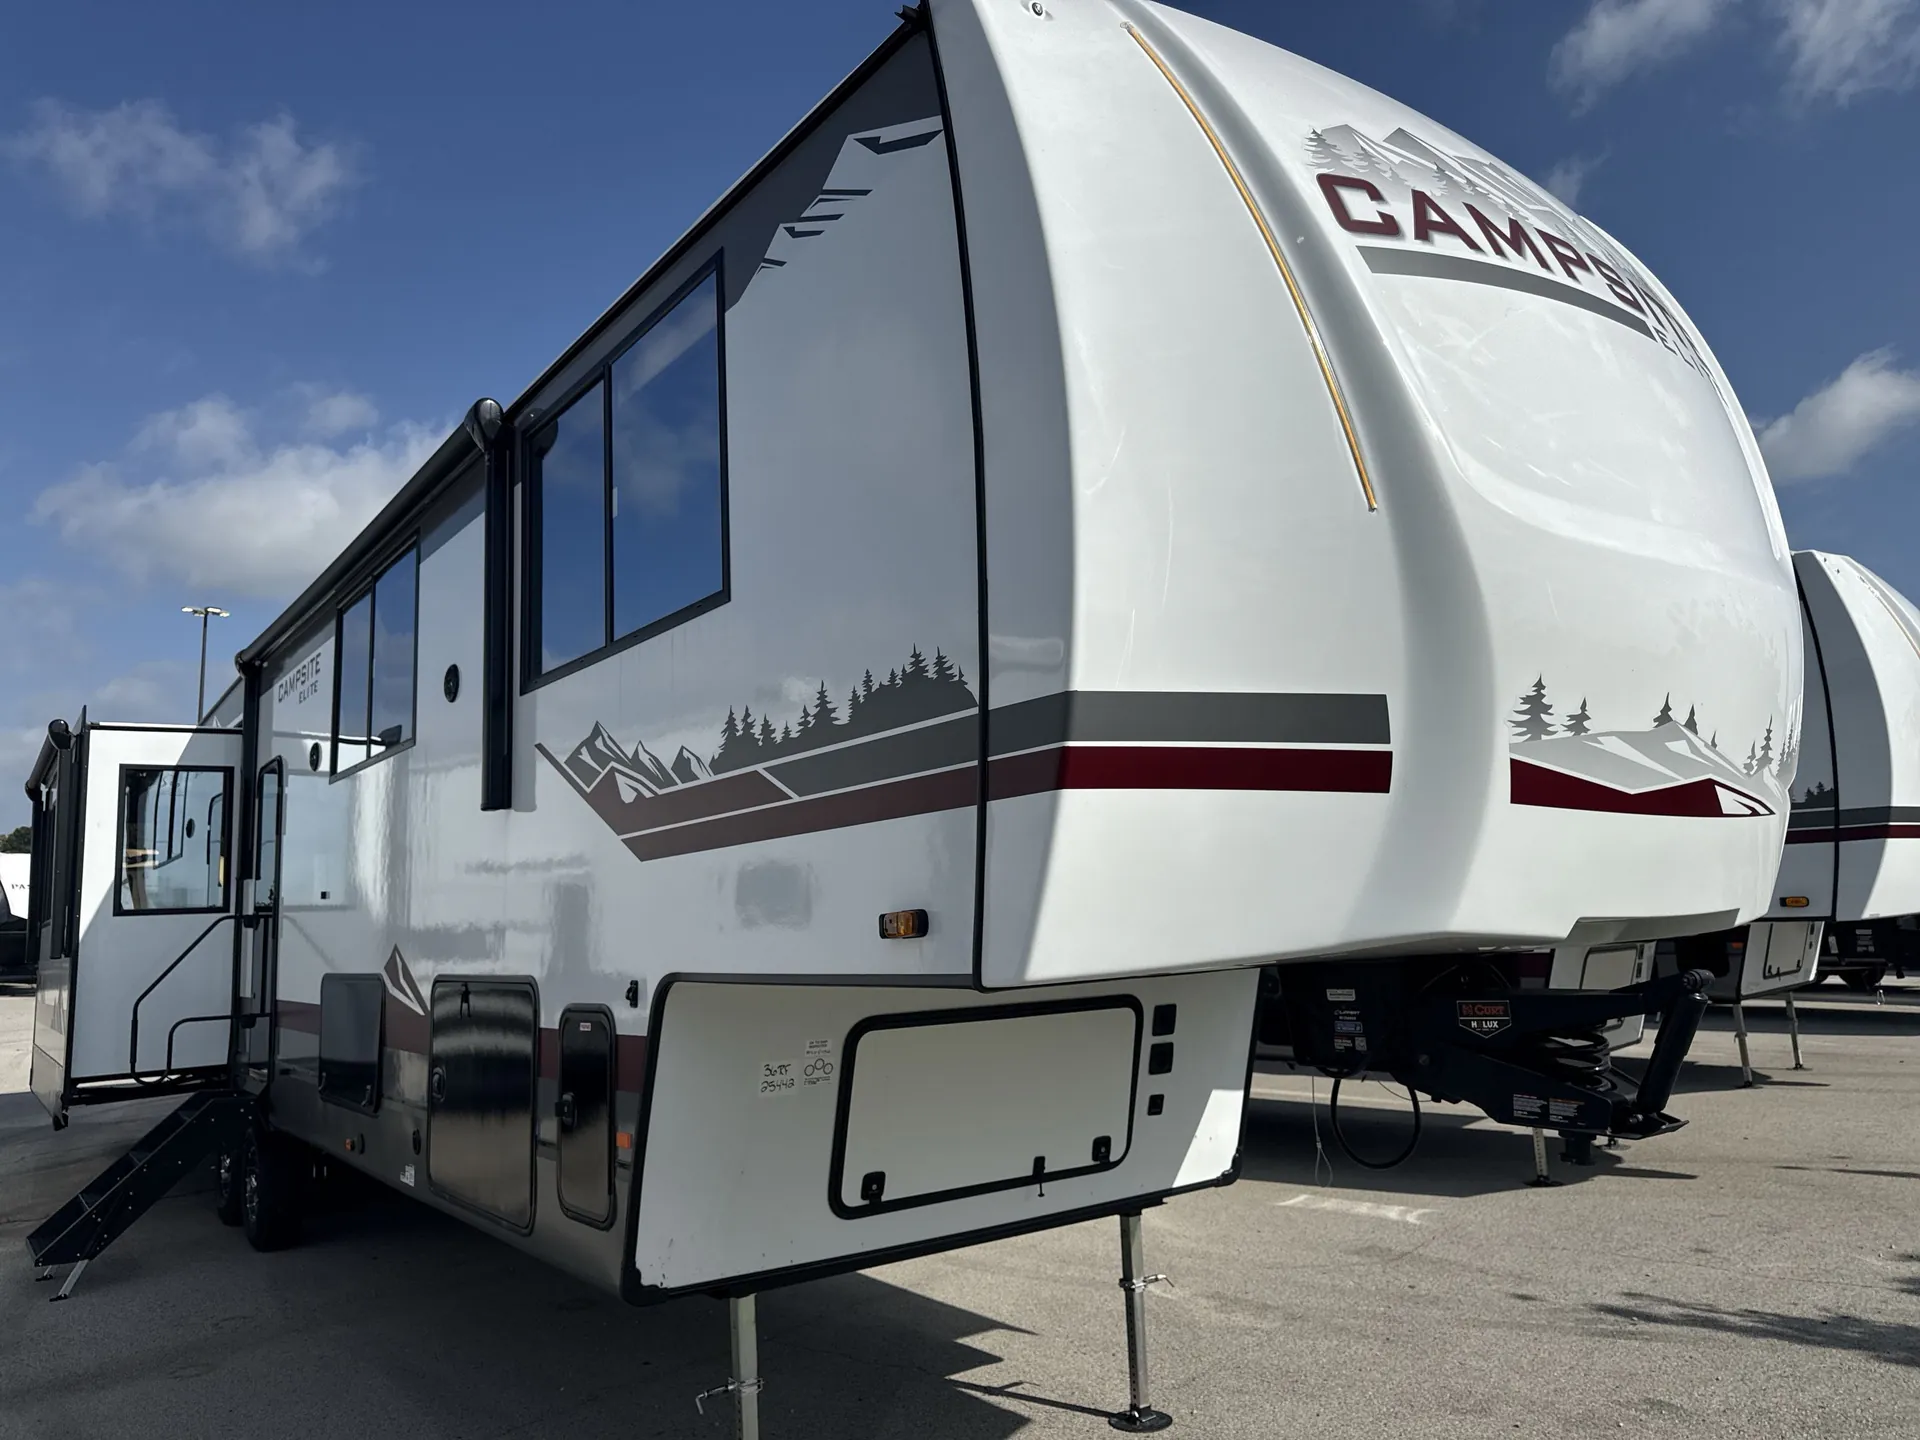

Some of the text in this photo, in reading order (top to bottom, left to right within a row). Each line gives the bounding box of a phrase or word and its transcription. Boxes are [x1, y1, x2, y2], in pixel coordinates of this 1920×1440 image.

[278, 652, 322, 703] CAMPSITE
[298, 680, 319, 704] ELITE
[760, 1078, 795, 1093] 25442
